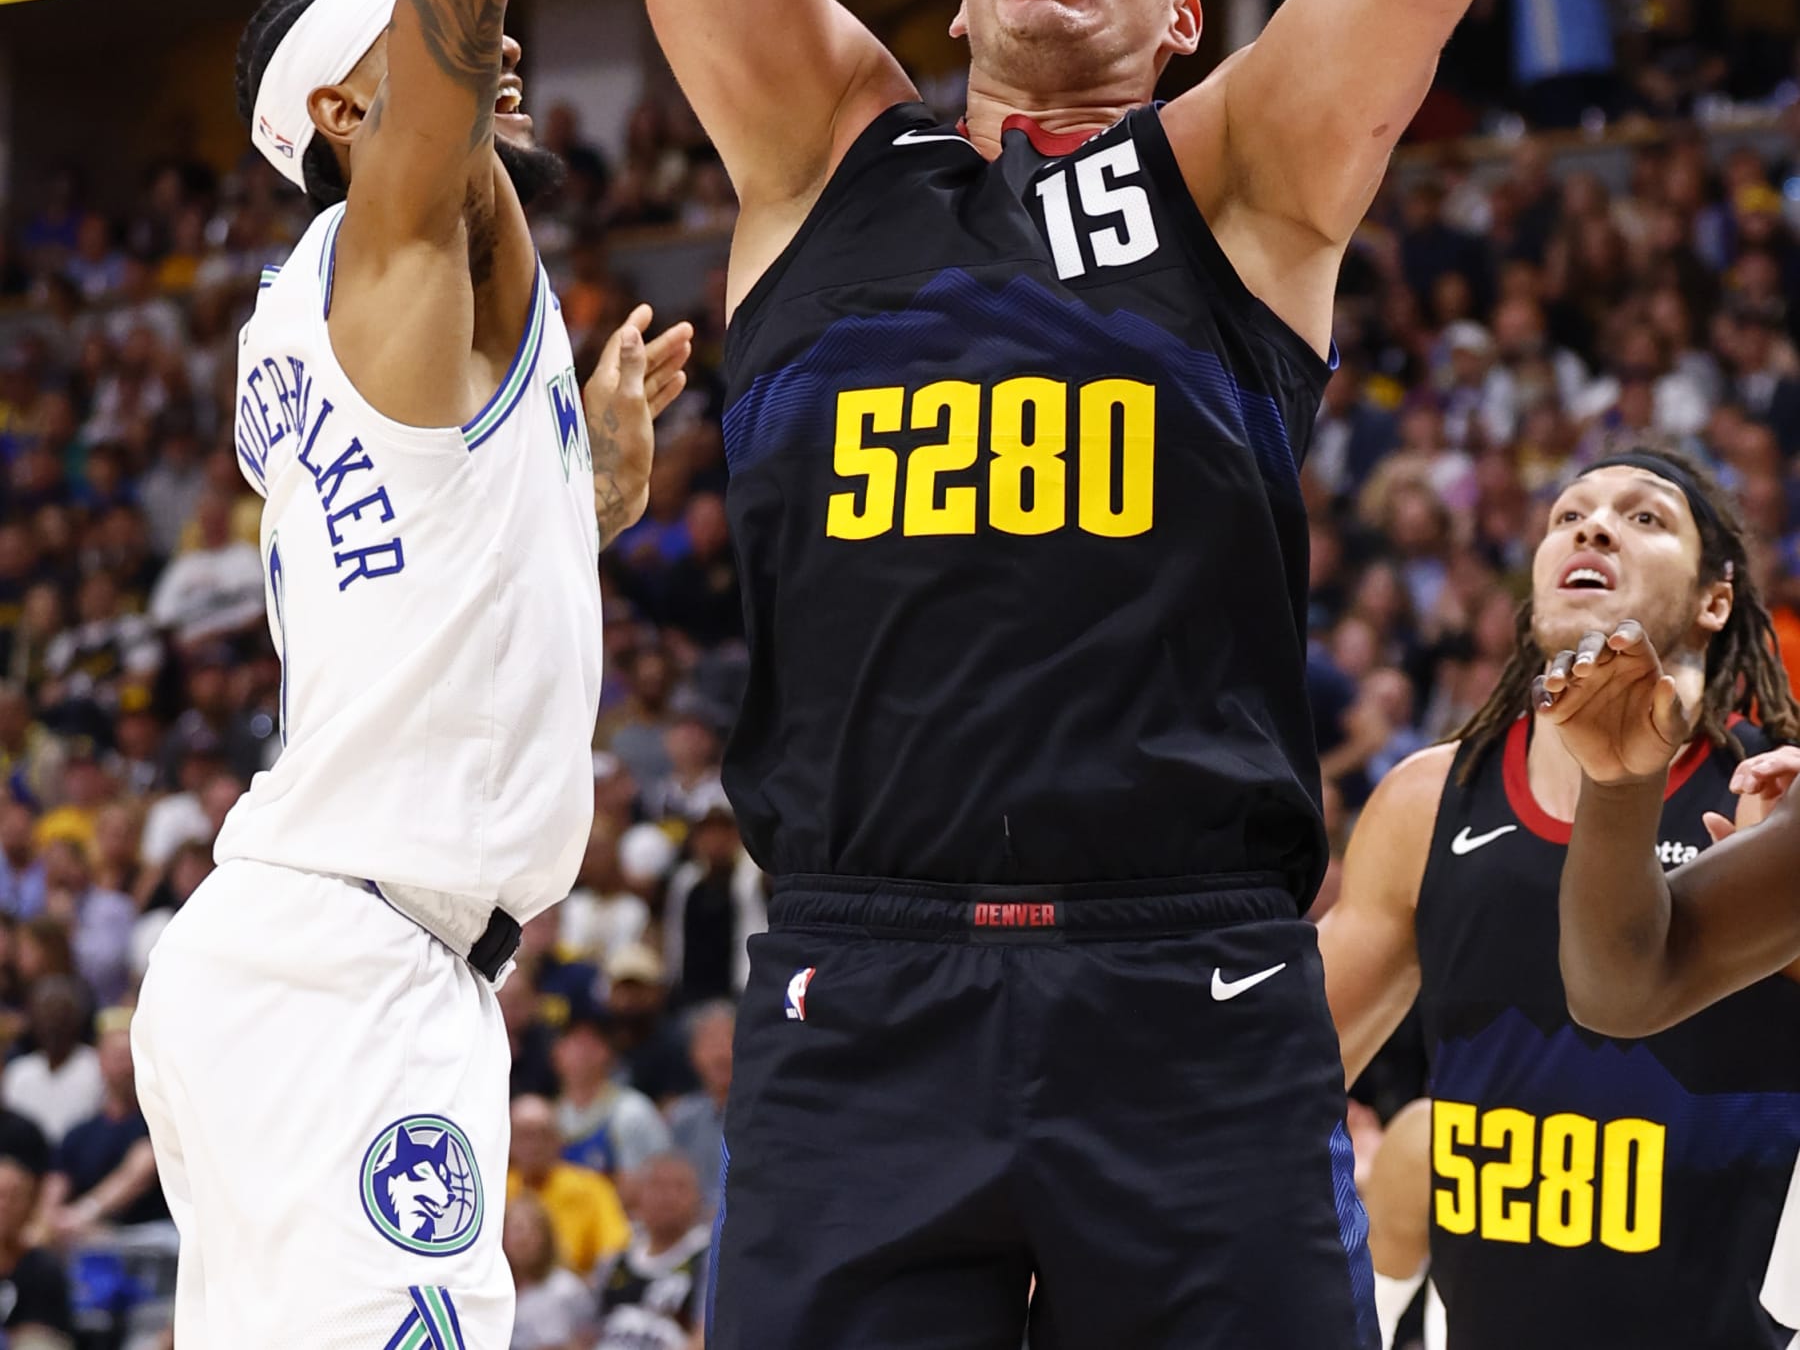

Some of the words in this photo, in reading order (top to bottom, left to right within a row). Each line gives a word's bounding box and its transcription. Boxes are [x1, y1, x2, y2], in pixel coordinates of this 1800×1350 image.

[1035, 139, 1160, 281] 15
[825, 376, 1156, 540] 5280
[974, 902, 1056, 927] DENVER
[1655, 840, 1699, 864] tta
[1432, 1099, 1666, 1253] 5280
